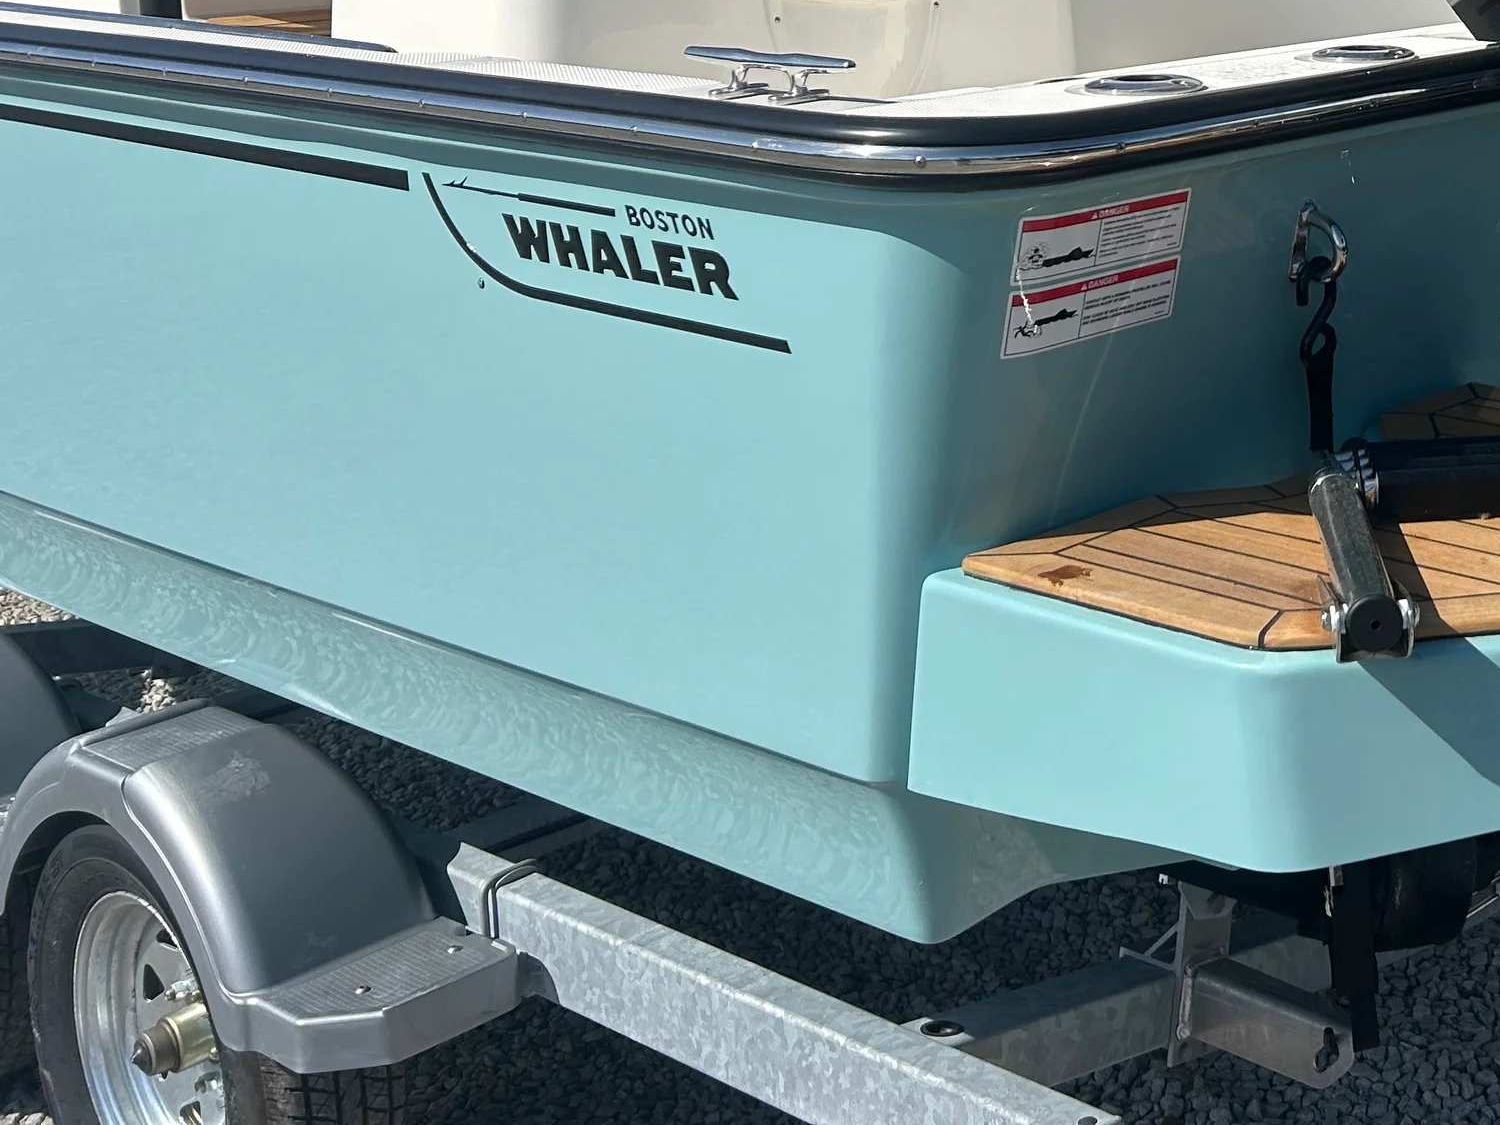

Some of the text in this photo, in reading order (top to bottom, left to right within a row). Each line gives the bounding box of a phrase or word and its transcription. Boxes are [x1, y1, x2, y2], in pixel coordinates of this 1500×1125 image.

[624, 204, 715, 241] BOSTON
[1099, 205, 1130, 218] DANGER
[501, 212, 740, 301] WHALER
[1088, 275, 1119, 289] DANGER
